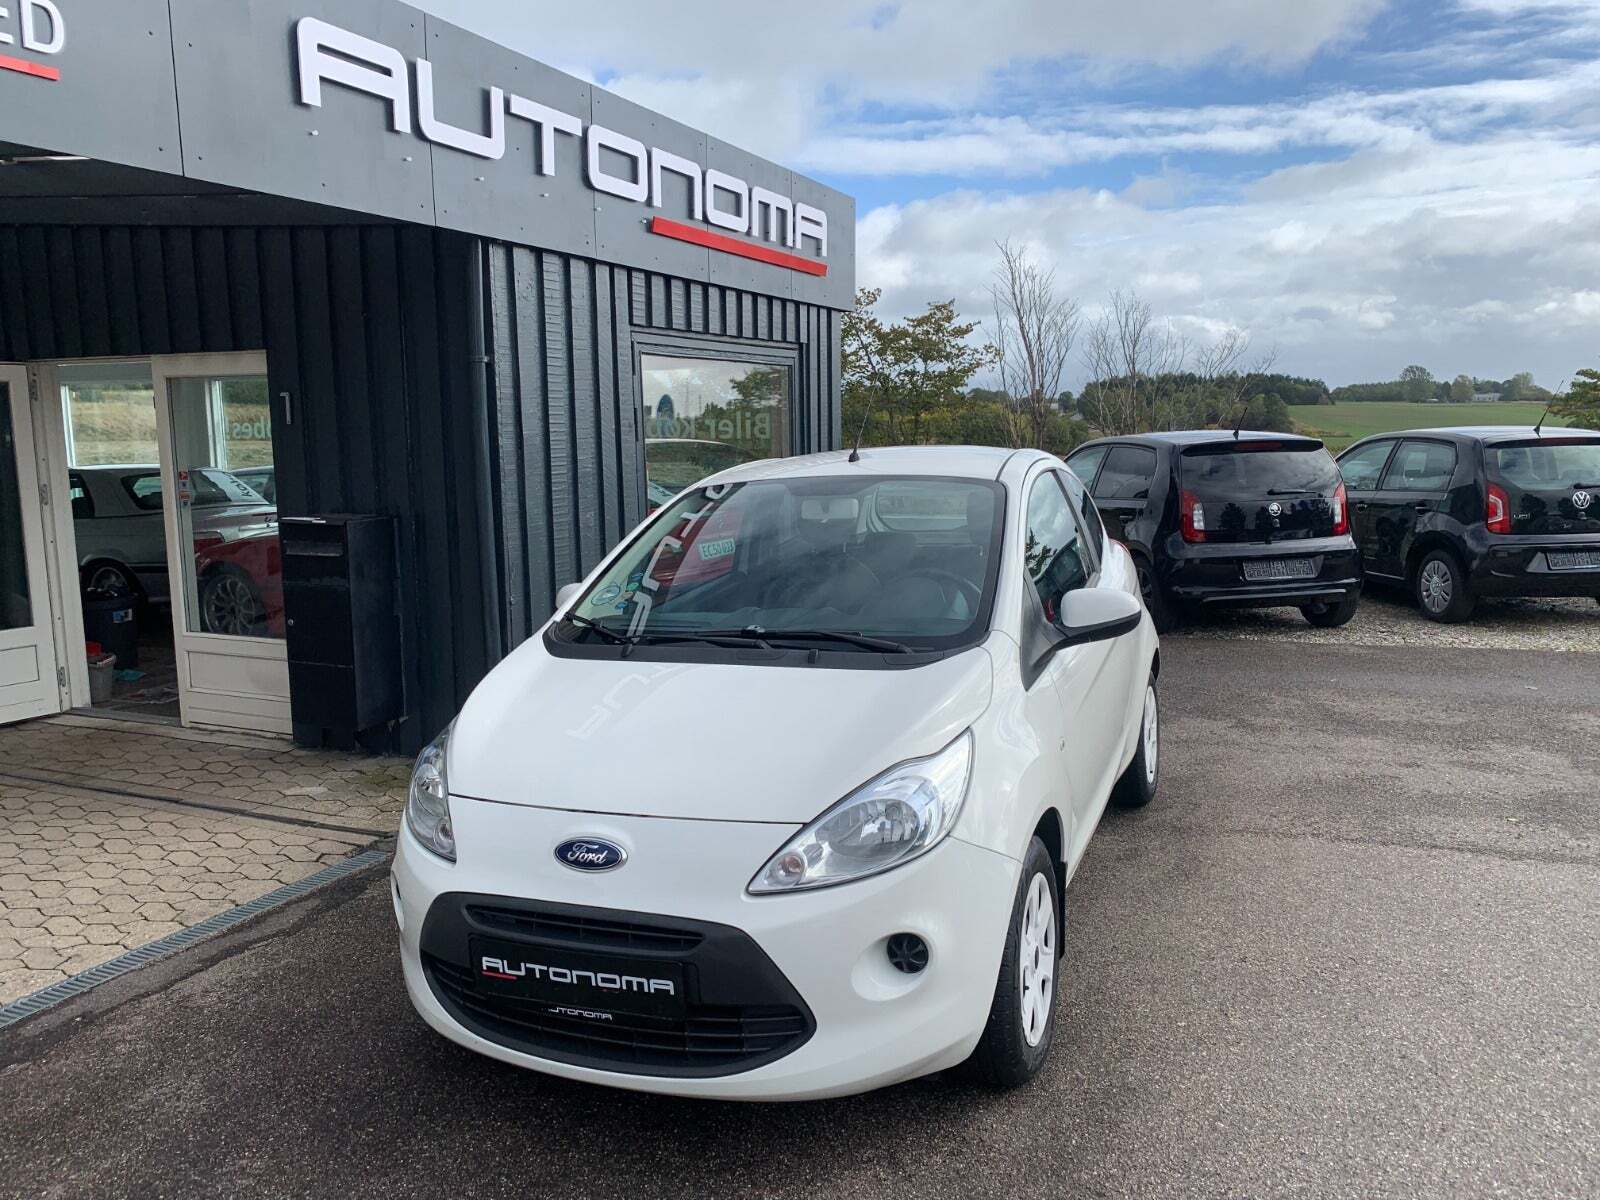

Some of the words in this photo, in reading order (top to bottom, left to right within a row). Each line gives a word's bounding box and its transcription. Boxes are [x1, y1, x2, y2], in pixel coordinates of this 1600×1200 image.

[297, 16, 828, 257] AUTONOMA
[567, 842, 608, 864] Ford
[482, 956, 675, 996] AUTONOMA
